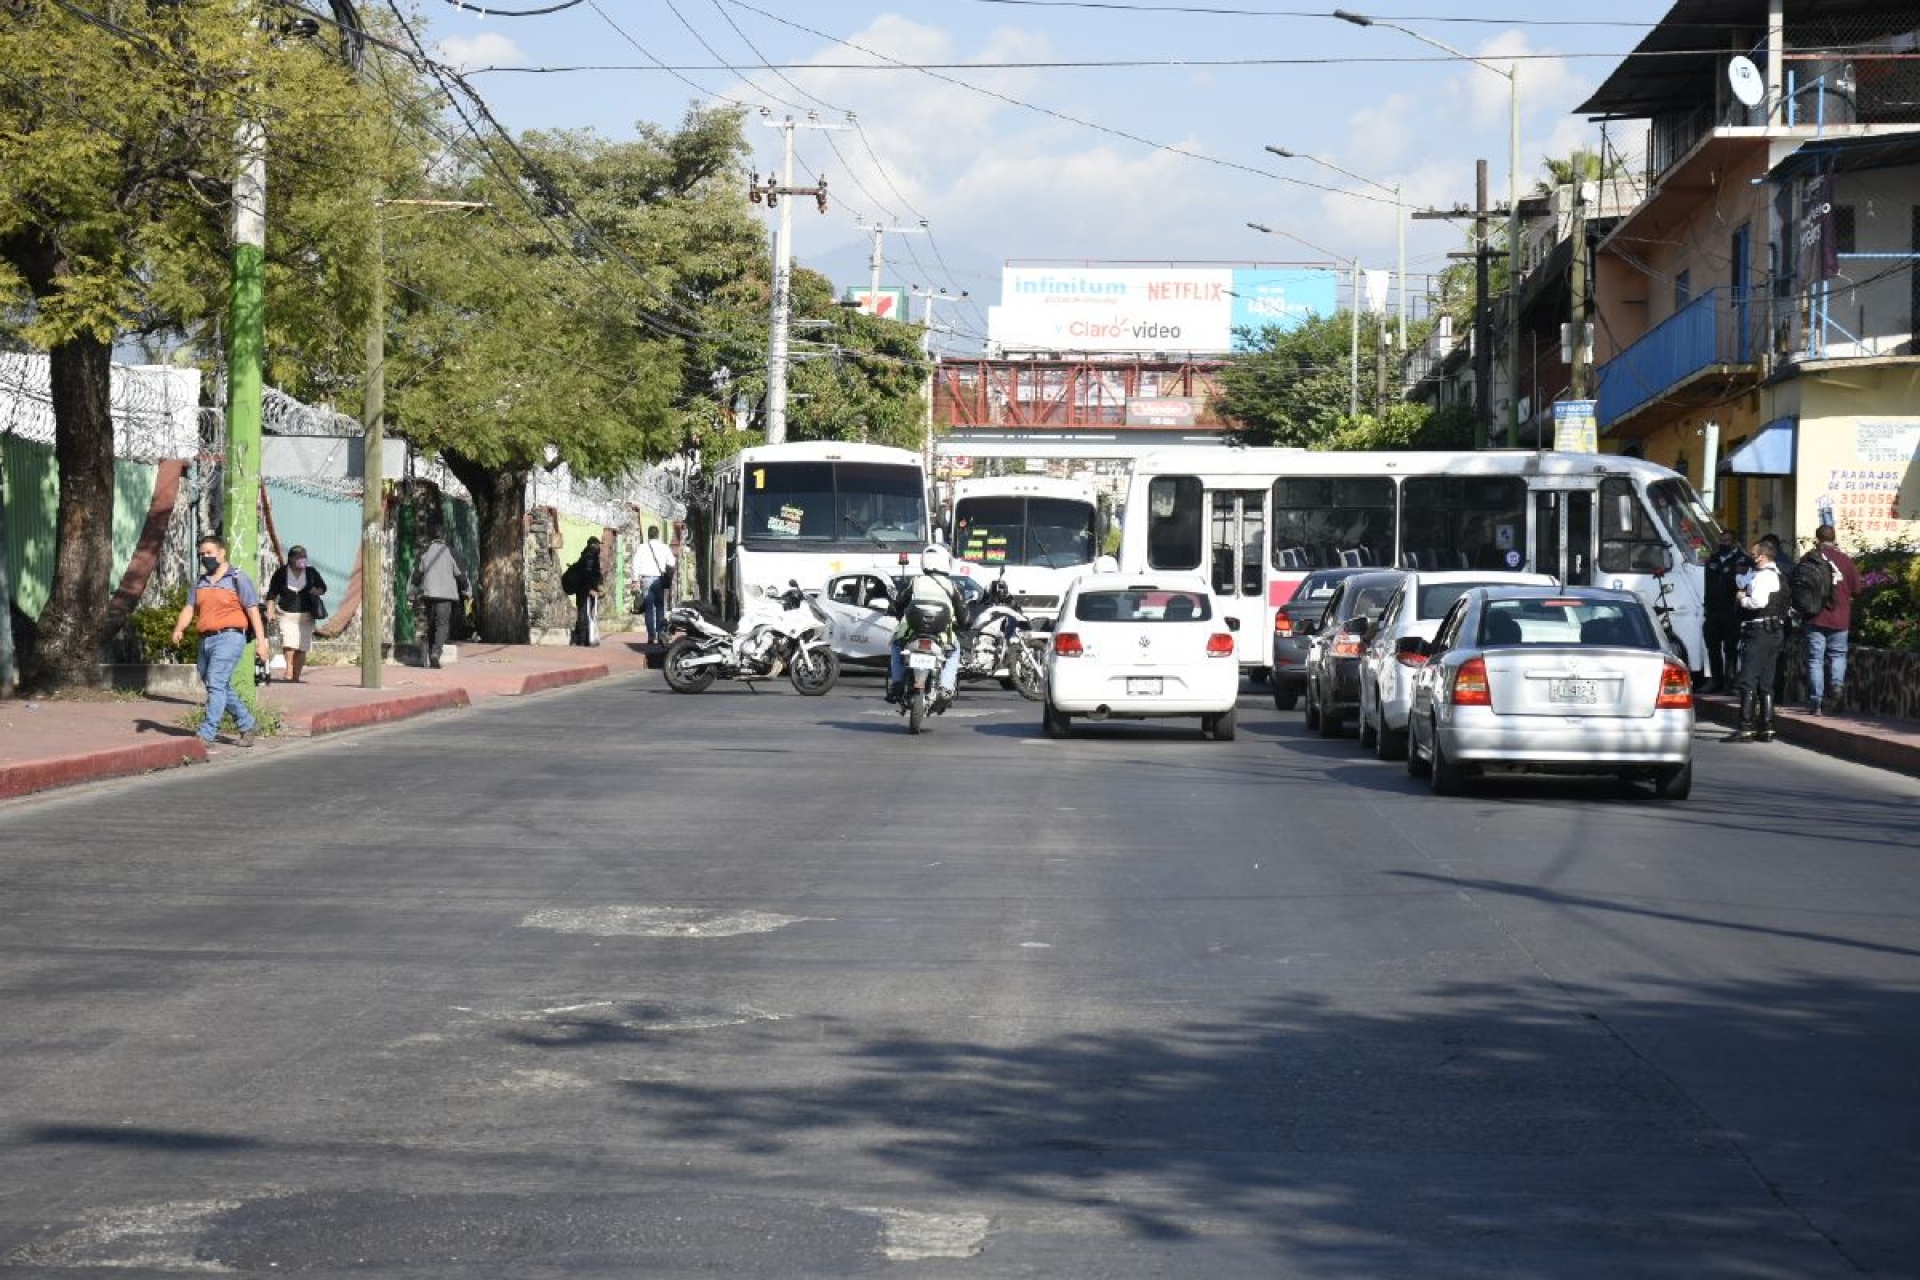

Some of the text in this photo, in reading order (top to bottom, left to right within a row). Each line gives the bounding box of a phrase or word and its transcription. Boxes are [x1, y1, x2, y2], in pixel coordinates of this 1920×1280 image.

[1014, 277, 1127, 294] infinitum
[1148, 281, 1223, 302] NETFLIX
[1069, 320, 1121, 338] Claro
[1132, 321, 1182, 339] video
[753, 468, 765, 489] 1
[1831, 470, 1899, 479] TRABAJOS
